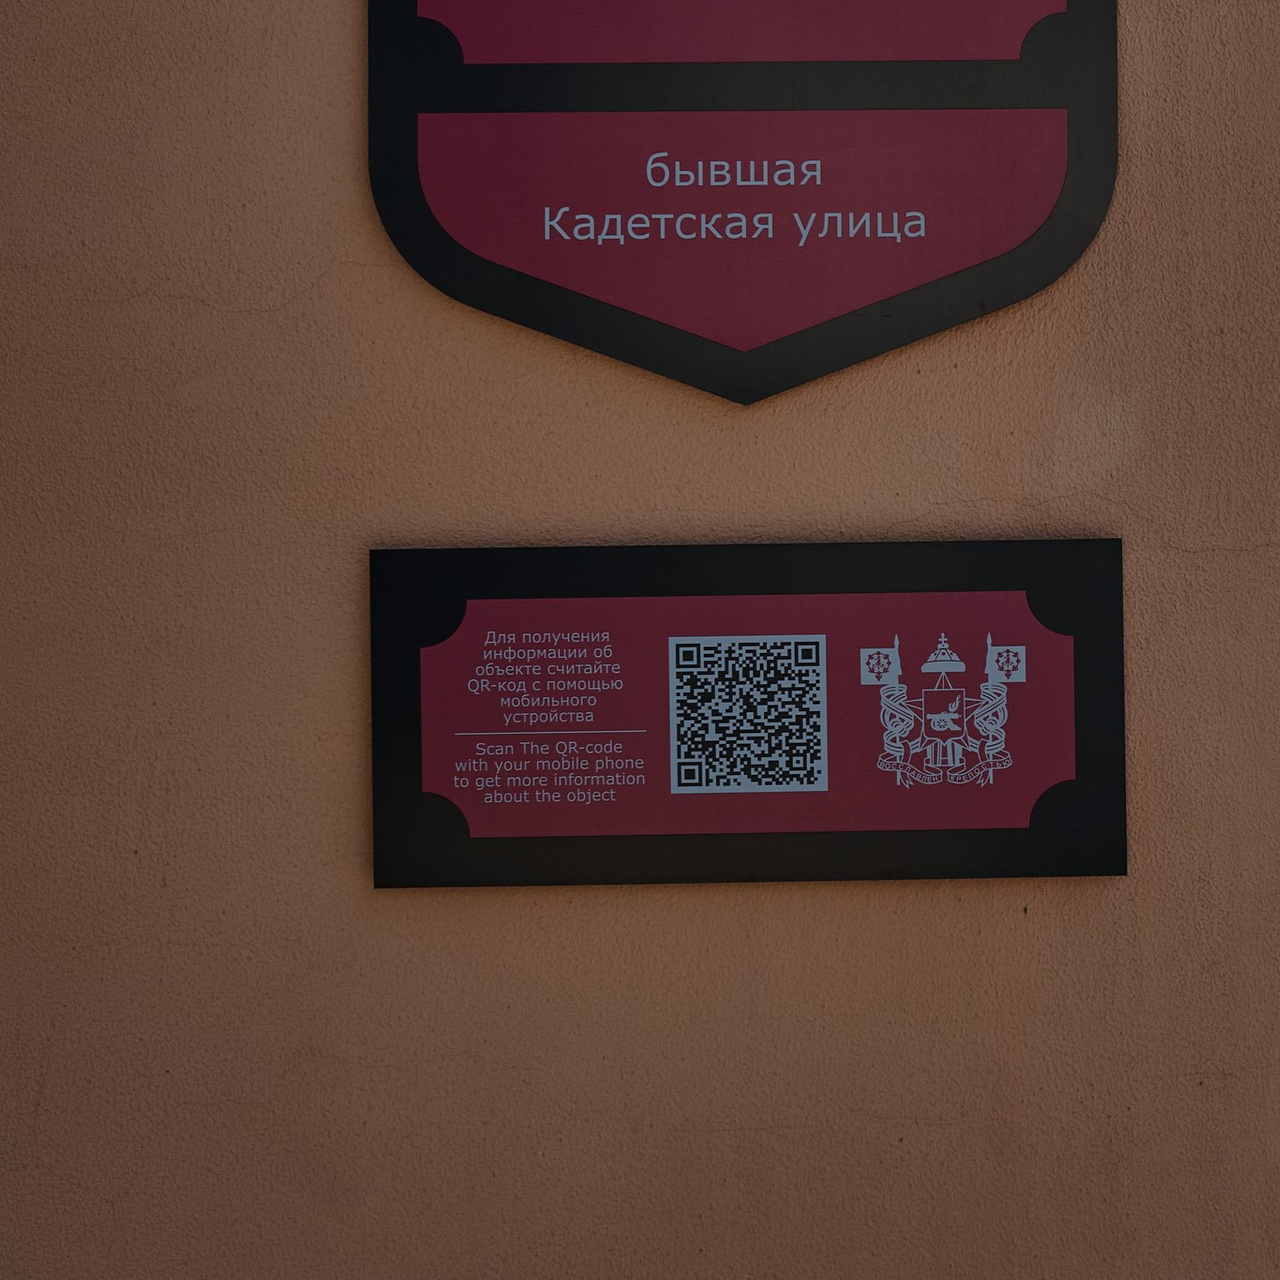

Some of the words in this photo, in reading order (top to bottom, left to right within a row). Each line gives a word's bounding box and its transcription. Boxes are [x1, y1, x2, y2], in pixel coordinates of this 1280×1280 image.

[647, 152, 821, 186] бывшая
[545, 207, 773, 245] Кадетская
[794, 212, 925, 246] улица
[485, 631, 515, 646] Для
[523, 632, 610, 647] получения
[484, 647, 586, 662] информации
[594, 645, 612, 658] об
[476, 663, 541, 676] объекте
[548, 661, 620, 674] считайте
[468, 679, 527, 694] QR-код
[533, 681, 540, 691] с
[547, 680, 623, 691] помощью
[501, 694, 596, 707] мобильного
[504, 710, 593, 725] устройства
[476, 743, 513, 755] Scan
[520, 742, 549, 754] The
[556, 741, 622, 756] QR-code
[455, 758, 487, 771] with
[495, 761, 530, 774] your
[537, 757, 588, 770] mobile
[596, 757, 643, 772] phone
[877, 761, 940, 784] ВОССЛАВЛЕН
[948, 759, 1011, 783] КРЕПОСТЬЮ
[454, 776, 469, 787] to
[476, 776, 500, 791] get
[508, 777, 547, 786] more
[555, 773, 644, 785] information
[484, 790, 529, 803] about
[535, 790, 560, 802] the
[567, 789, 615, 804] object
